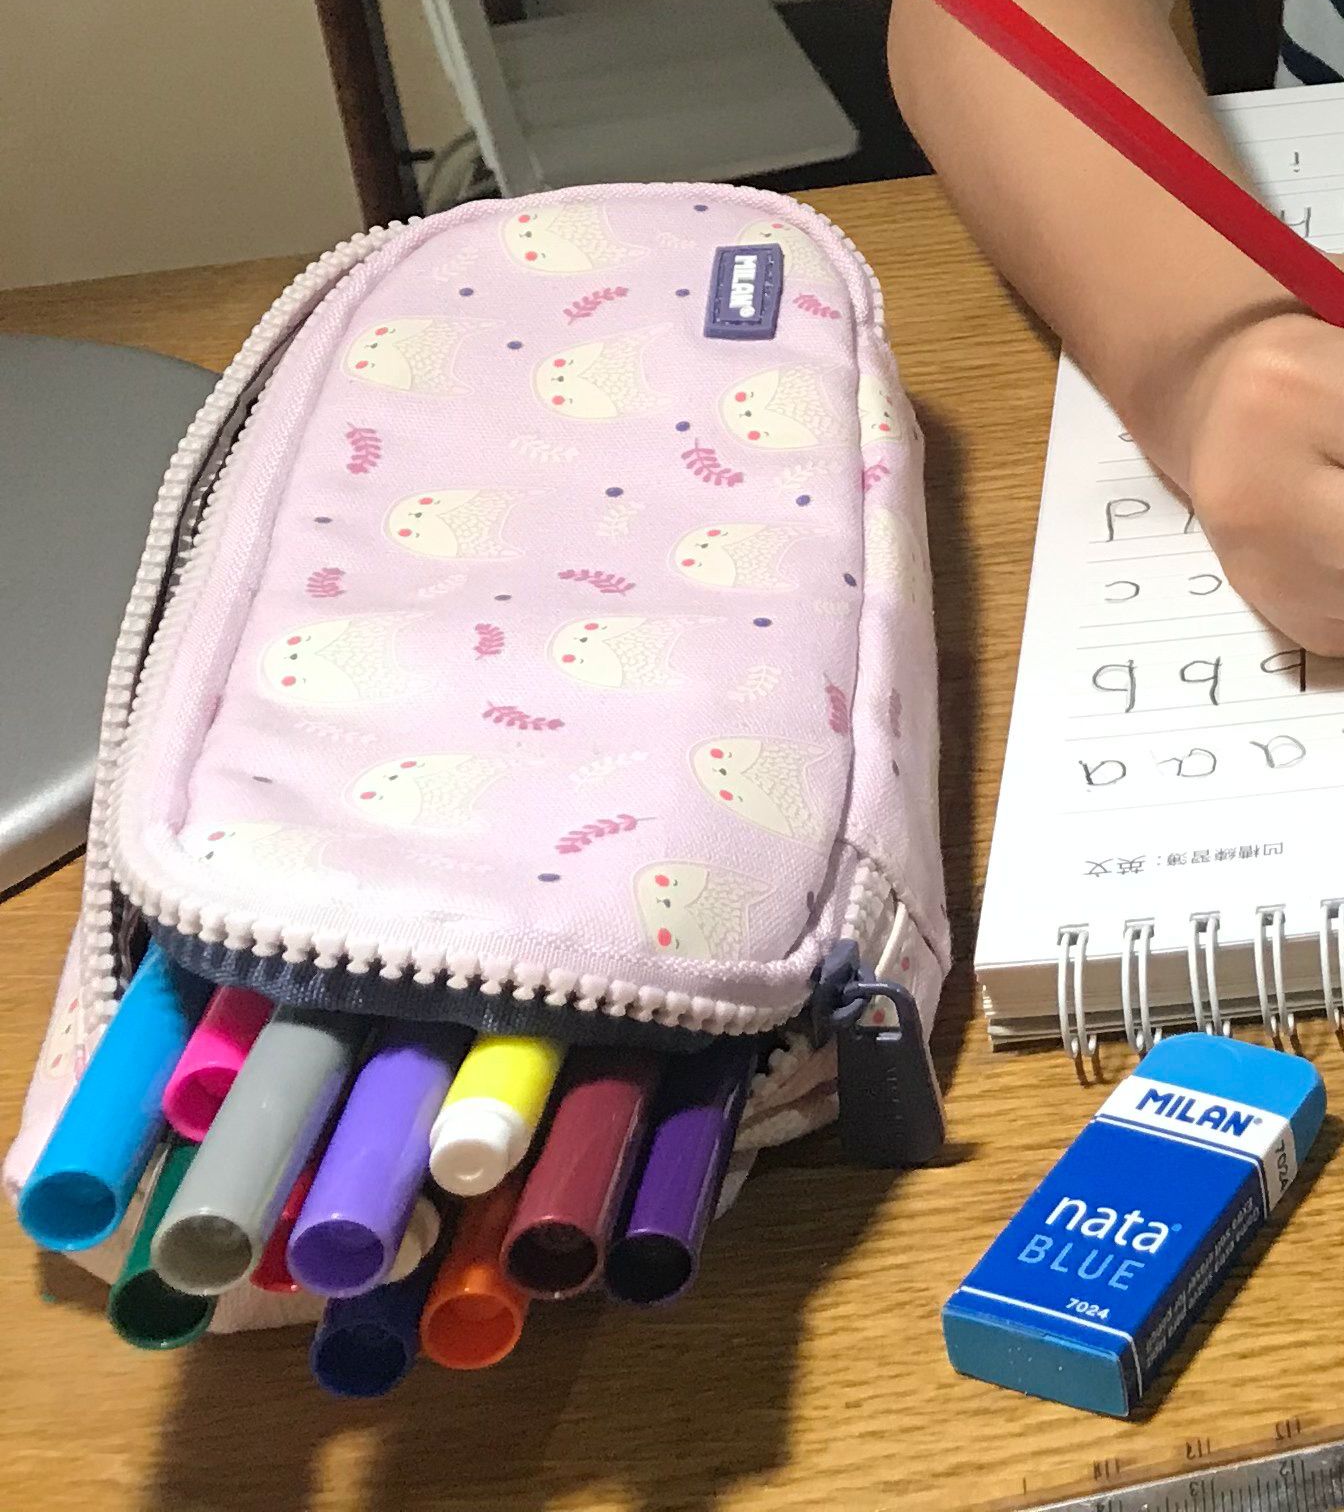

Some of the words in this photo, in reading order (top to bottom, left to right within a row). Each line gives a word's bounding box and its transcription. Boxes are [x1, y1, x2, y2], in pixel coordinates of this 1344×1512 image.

[729, 255, 757, 308] MILAN
[1136, 1088, 1253, 1137] MILAN
[1045, 1195, 1171, 1256] nata
[1017, 1235, 1145, 1291] BLUE
[1065, 1297, 1110, 1320] 7024
